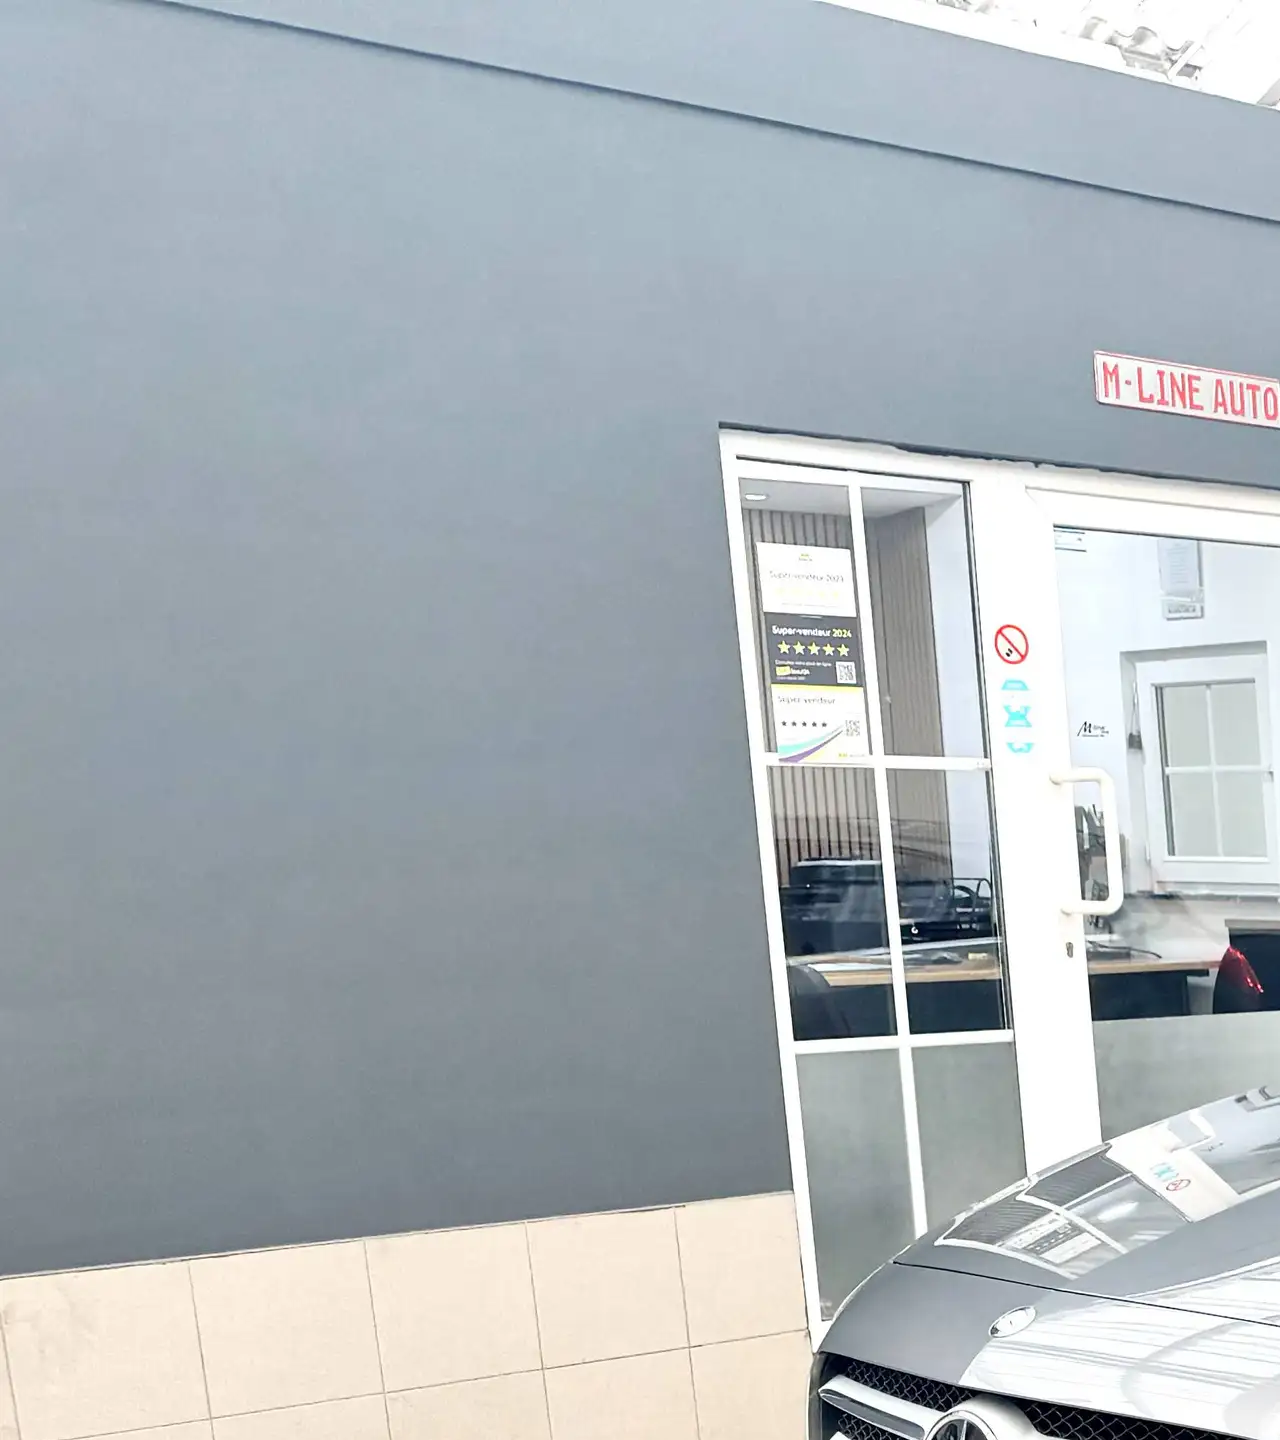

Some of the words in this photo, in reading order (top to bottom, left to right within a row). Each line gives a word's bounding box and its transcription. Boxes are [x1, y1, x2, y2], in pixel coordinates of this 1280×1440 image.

[1102, 360, 1205, 411] M-LINE
[1213, 378, 1279, 421] AUTO
[771, 625, 831, 639] Super-vendeur
